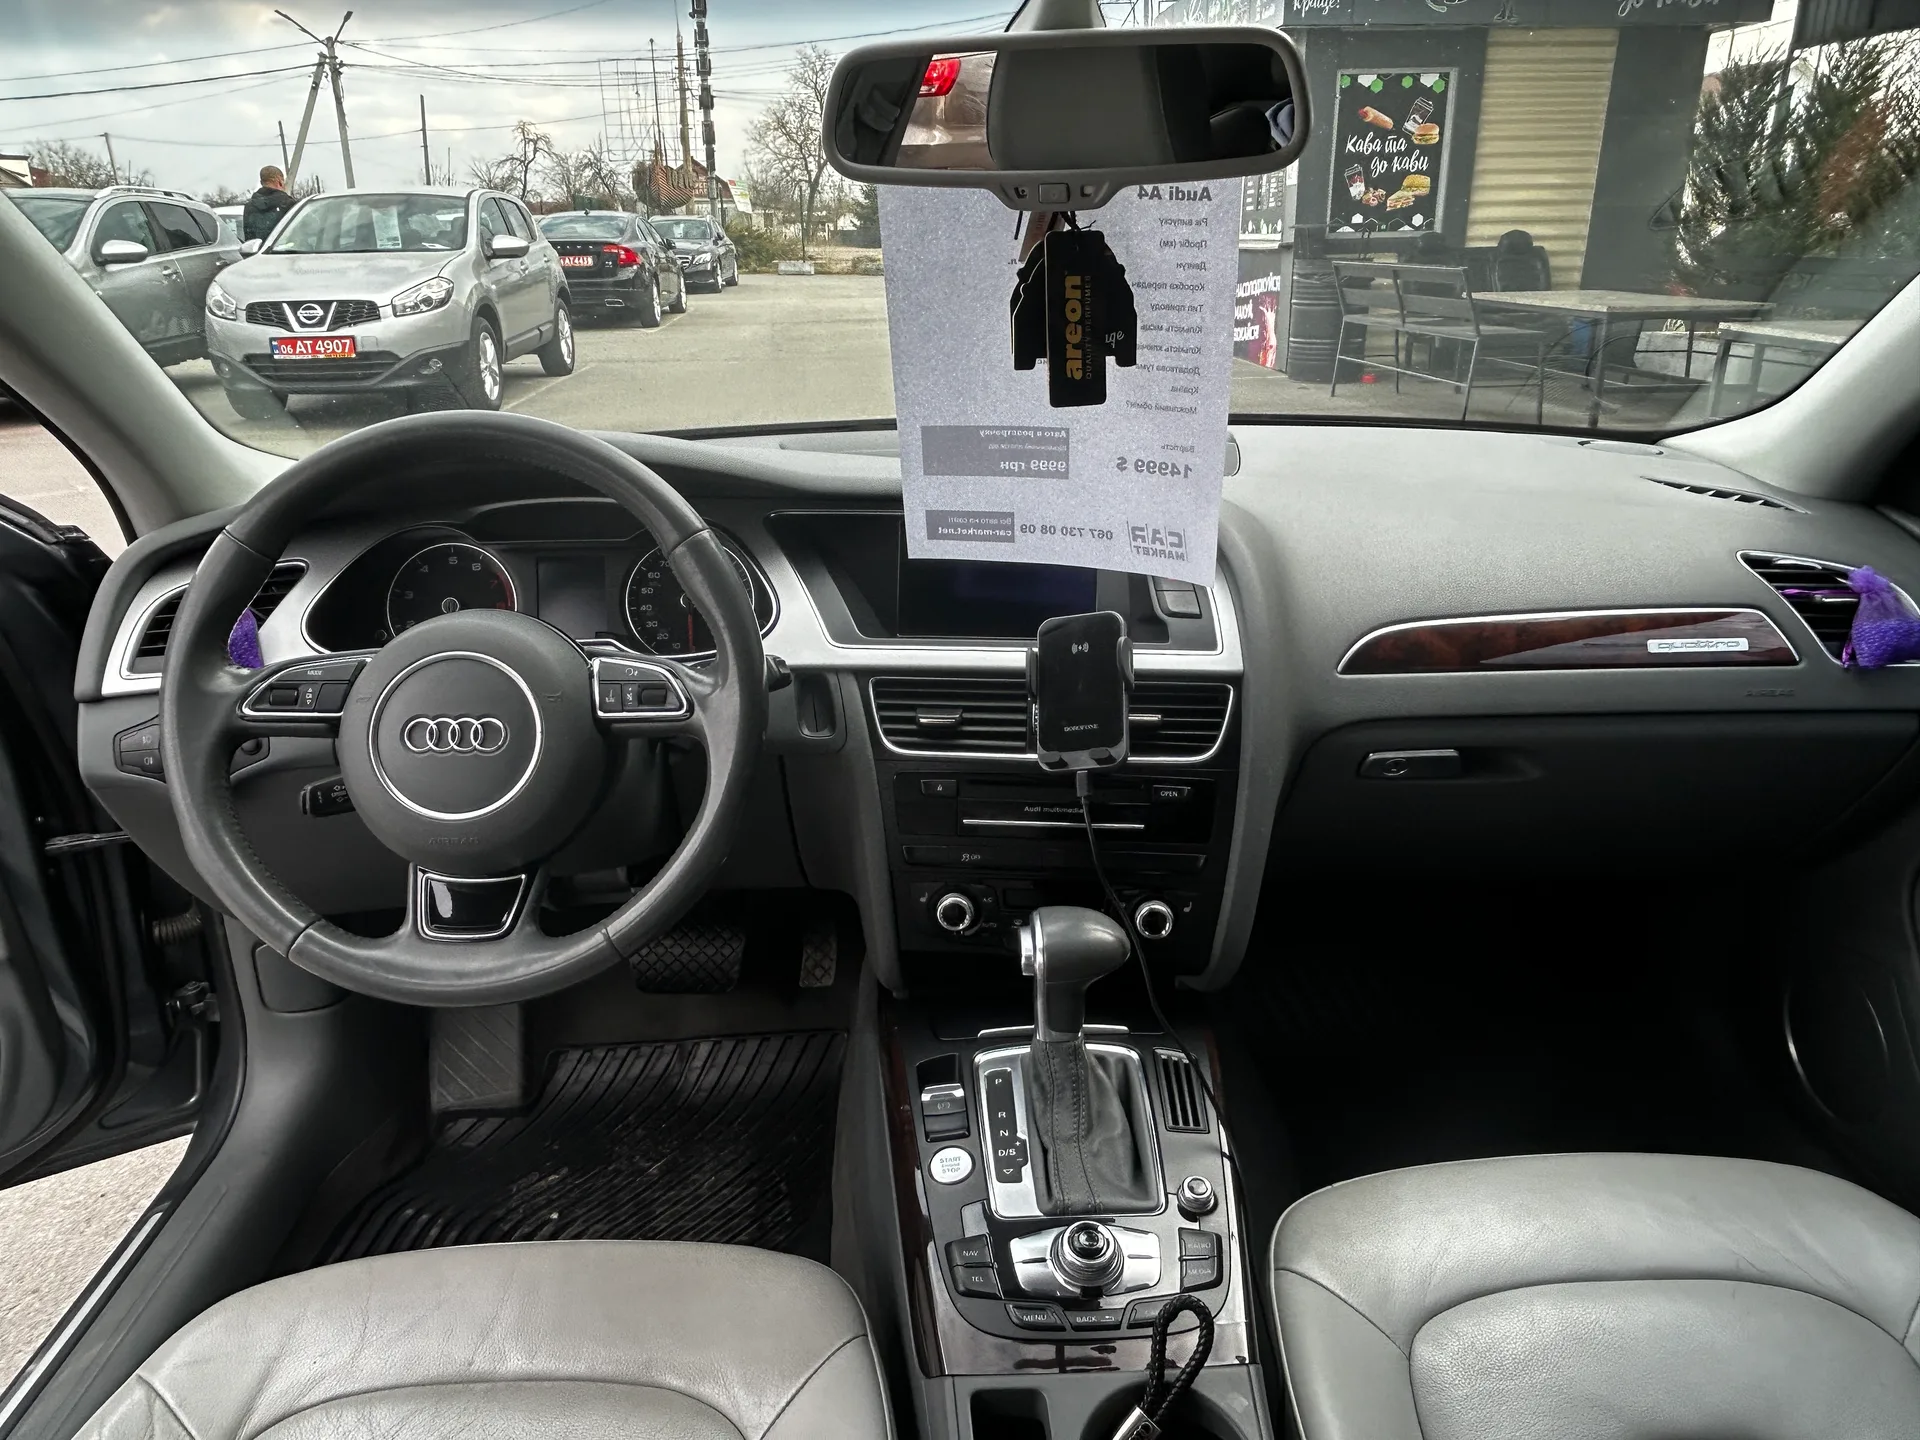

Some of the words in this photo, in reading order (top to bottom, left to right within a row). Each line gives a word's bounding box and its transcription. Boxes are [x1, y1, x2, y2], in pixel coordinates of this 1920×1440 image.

[1345, 131, 1383, 154] Кава
[1385, 135, 1408, 152] та
[1370, 155, 1388, 178] до
[1391, 150, 1430, 173] кави
[1065, 275, 1083, 381] areon
[280, 344, 293, 355] 06
[295, 340, 313, 355] AT
[315, 339, 351, 355] 4907
[1083, 336, 1092, 380] QUALITY
[647, 571, 661, 579] 60
[645, 620, 658, 628] 30
[656, 632, 669, 640] 20
[1657, 640, 1741, 652] quattro
[1160, 789, 1178, 797] OPEN
[1023, 805, 1042, 813] Audi
[1000, 1129, 1009, 1137] N
[998, 1148, 1017, 1157] D/S
[939, 1156, 962, 1164] START
